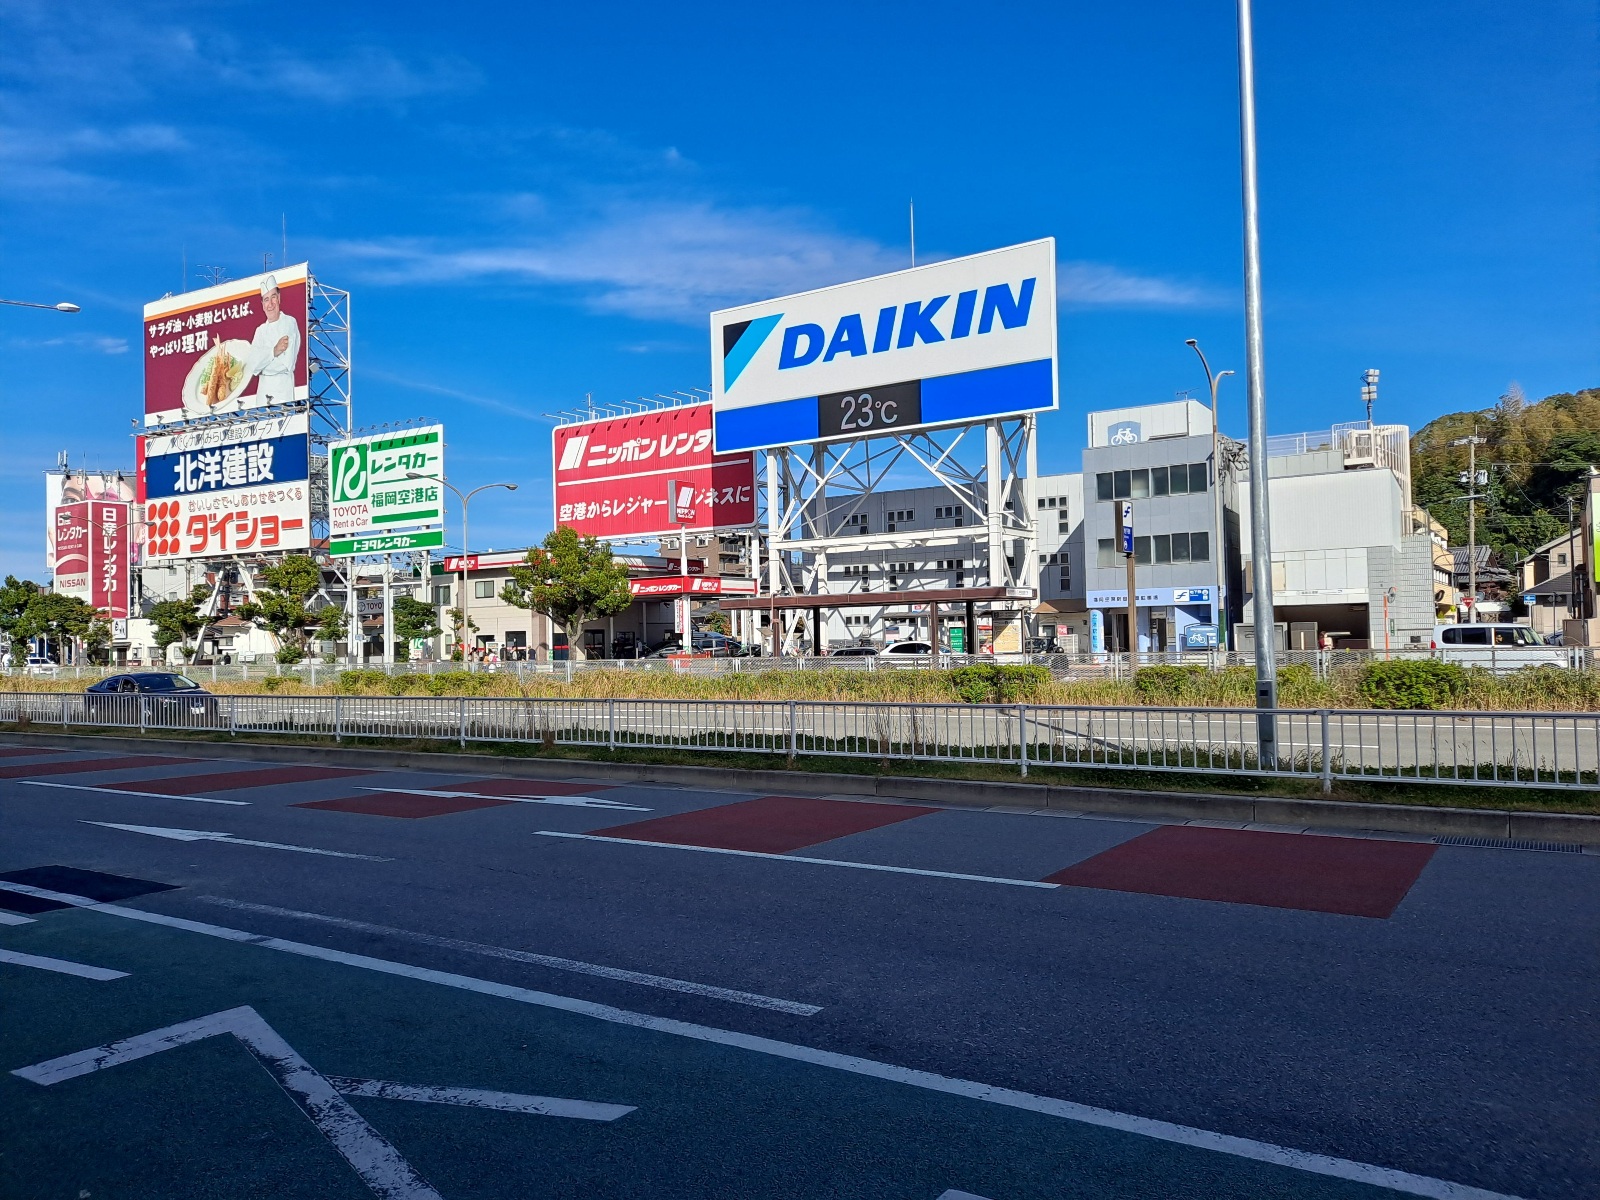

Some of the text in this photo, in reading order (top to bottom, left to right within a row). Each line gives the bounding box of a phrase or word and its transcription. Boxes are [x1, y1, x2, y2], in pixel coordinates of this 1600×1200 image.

[778, 277, 1037, 371] DAIKIN
[149, 330, 209, 358] やっぱり理研
[174, 442, 274, 493] 北洋建設
[371, 452, 438, 474] レンタカー
[371, 486, 438, 508] 福岡空港店
[333, 504, 369, 517] TOYOTA
[186, 510, 304, 553] ダイショー
[333, 520, 349, 529] Rent
[356, 518, 368, 527] Car
[58, 526, 87, 541] レンタカー
[353, 537, 416, 551] トヨタレンタカー
[60, 578, 86, 588] NISSAN
[367, 601, 384, 610] TOYO
